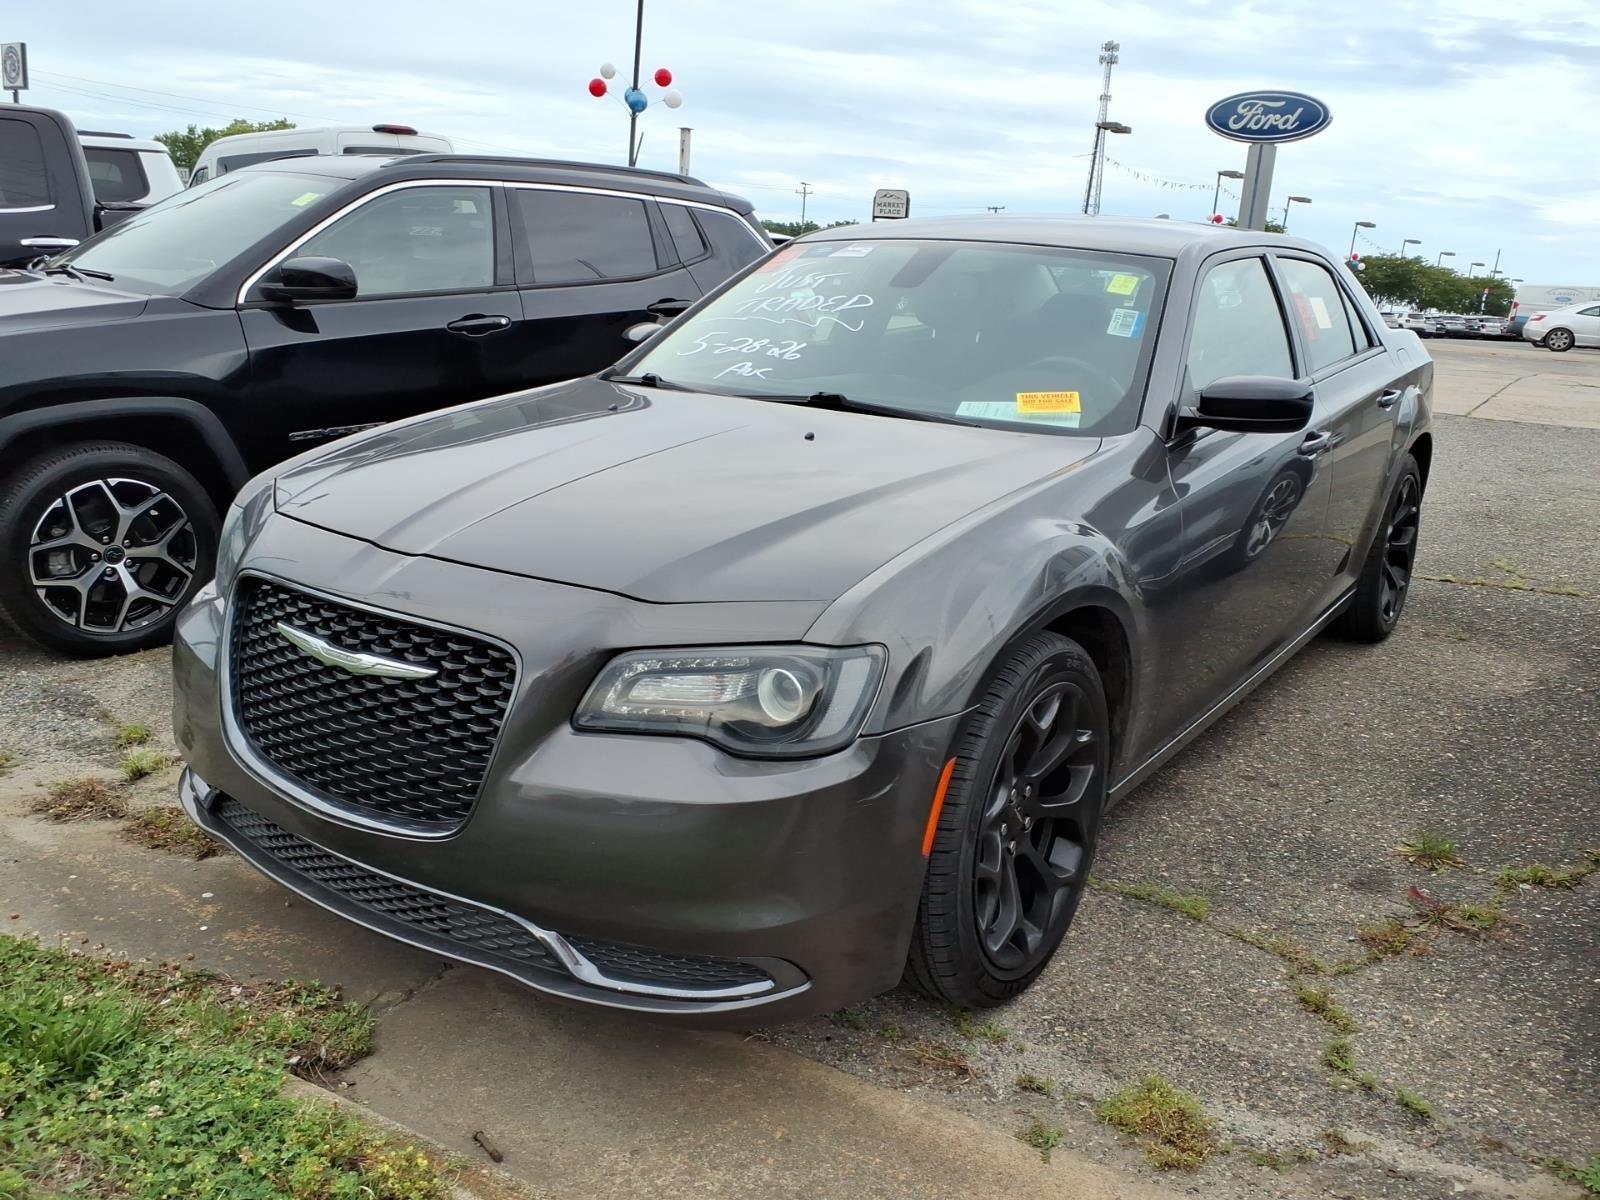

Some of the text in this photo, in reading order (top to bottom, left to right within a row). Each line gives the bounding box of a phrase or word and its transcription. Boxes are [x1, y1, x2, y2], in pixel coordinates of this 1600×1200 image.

[1228, 99, 1304, 130] Ford
[735, 294, 874, 315] TRADED
[677, 331, 807, 361] 5-28-26
